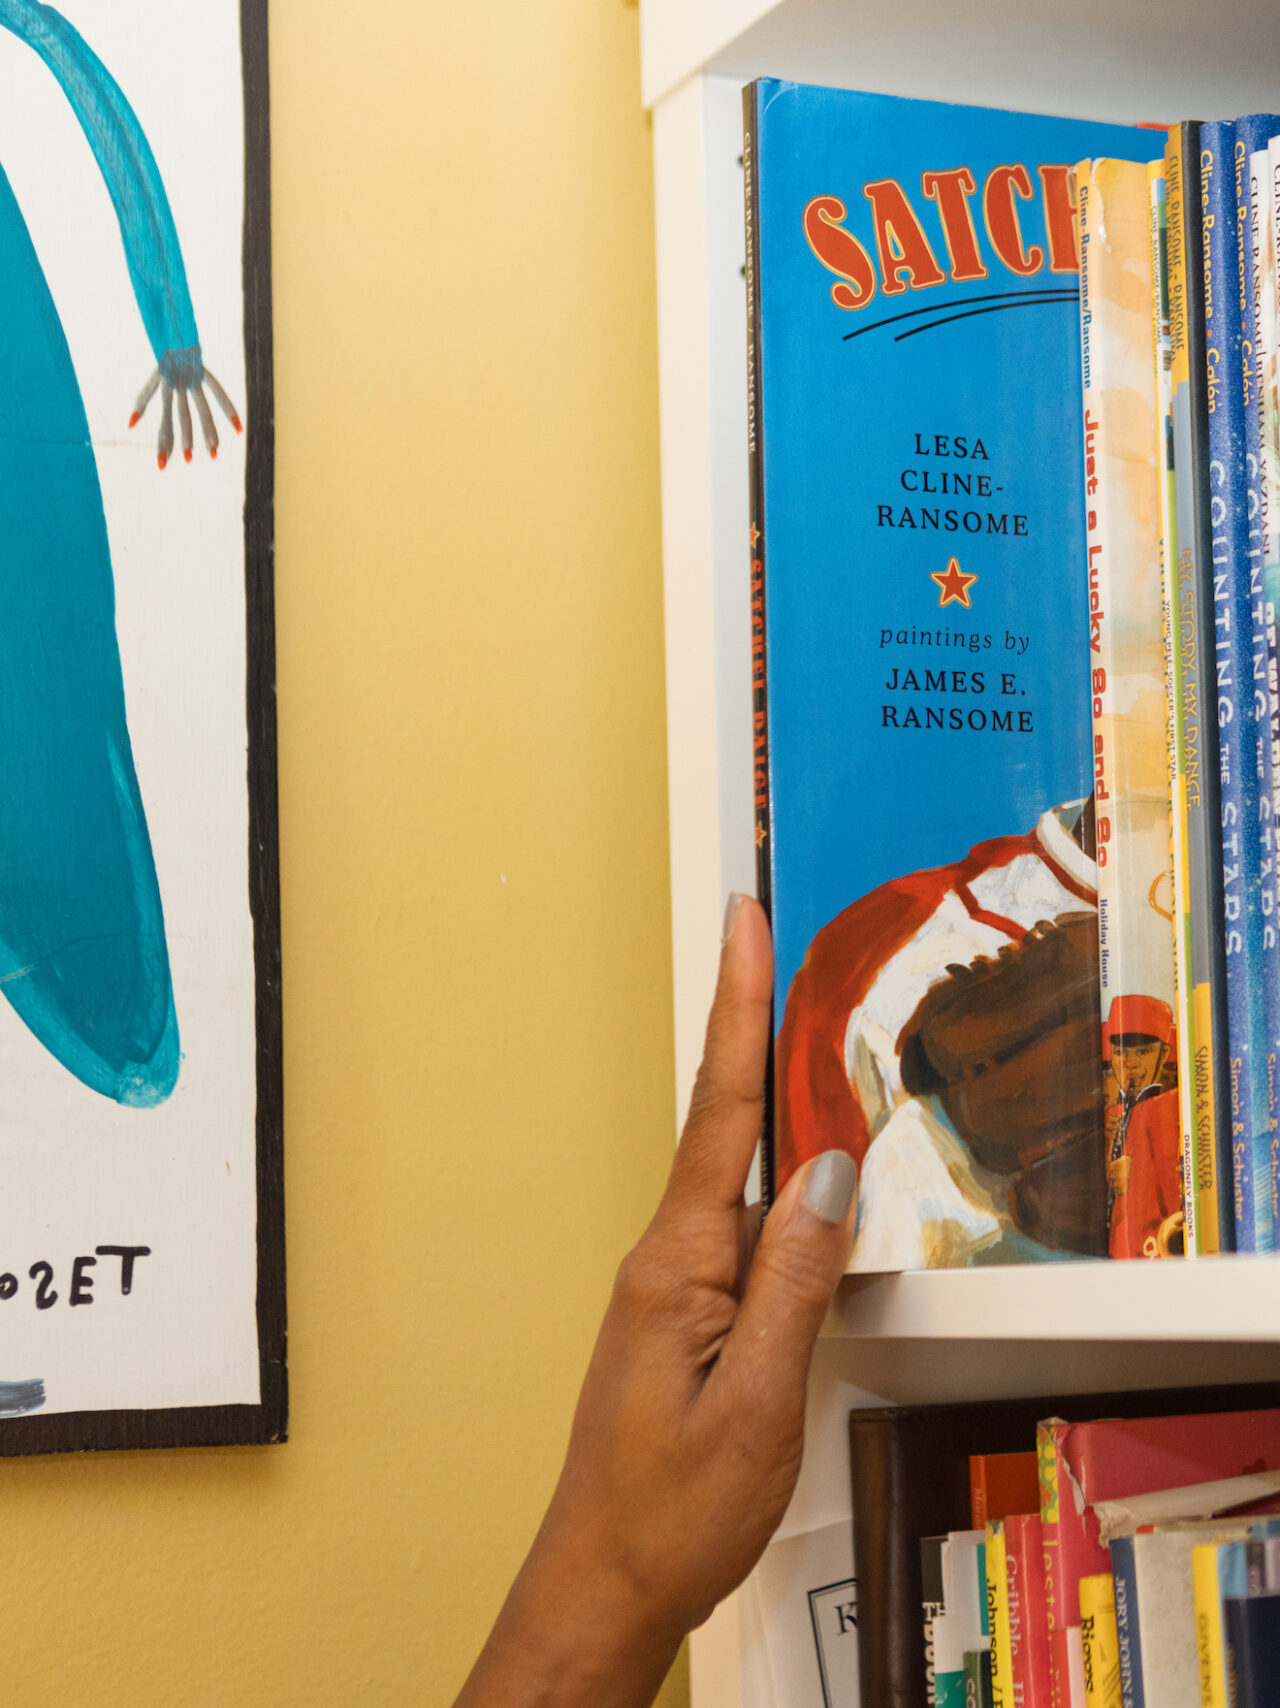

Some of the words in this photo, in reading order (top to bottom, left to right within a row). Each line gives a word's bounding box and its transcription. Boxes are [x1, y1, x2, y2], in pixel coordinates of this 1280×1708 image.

[743, 132, 754, 319] CLINE-RANSOME
[1200, 149, 1215, 319] Cline-Ransome
[1234, 140, 1247, 311] Cline-Ransome
[1079, 185, 1093, 390] Cline-Ransome/Ransome
[747, 343, 756, 456] RANSOME
[1206, 347, 1221, 414] Colón
[914, 433, 990, 462] LESA
[1084, 409, 1099, 496] Just
[900, 469, 1004, 499] CLINE-
[876, 505, 1030, 537] RANSOME
[1087, 510, 1098, 531] a
[1087, 545, 1105, 654] Lucky
[1209, 460, 1235, 728] COUNTING
[879, 626, 994, 654] paintings
[1003, 630, 1031, 655] by
[885, 668, 986, 693] JAMES
[1000, 671, 1027, 697] E.
[1092, 668, 1107, 719] So
[880, 705, 1035, 734] RANSOME
[1093, 734, 1110, 801] and
[1219, 743, 1231, 785] THE
[1096, 815, 1112, 869] So
[1221, 802, 1242, 956] STARS
[1099, 898, 1110, 945] Holiday
[1100, 949, 1111, 989] House
[1229, 1056, 1245, 1117] Simon
[1231, 1121, 1245, 1137] &
[1183, 1134, 1192, 1199] DRAGONFLY
[1232, 1142, 1246, 1222] Schuster
[1186, 1201, 1194, 1239] BOOKS
[1115, 1575, 1129, 1631] JORY
[1119, 1632, 1133, 1694] JOHN
